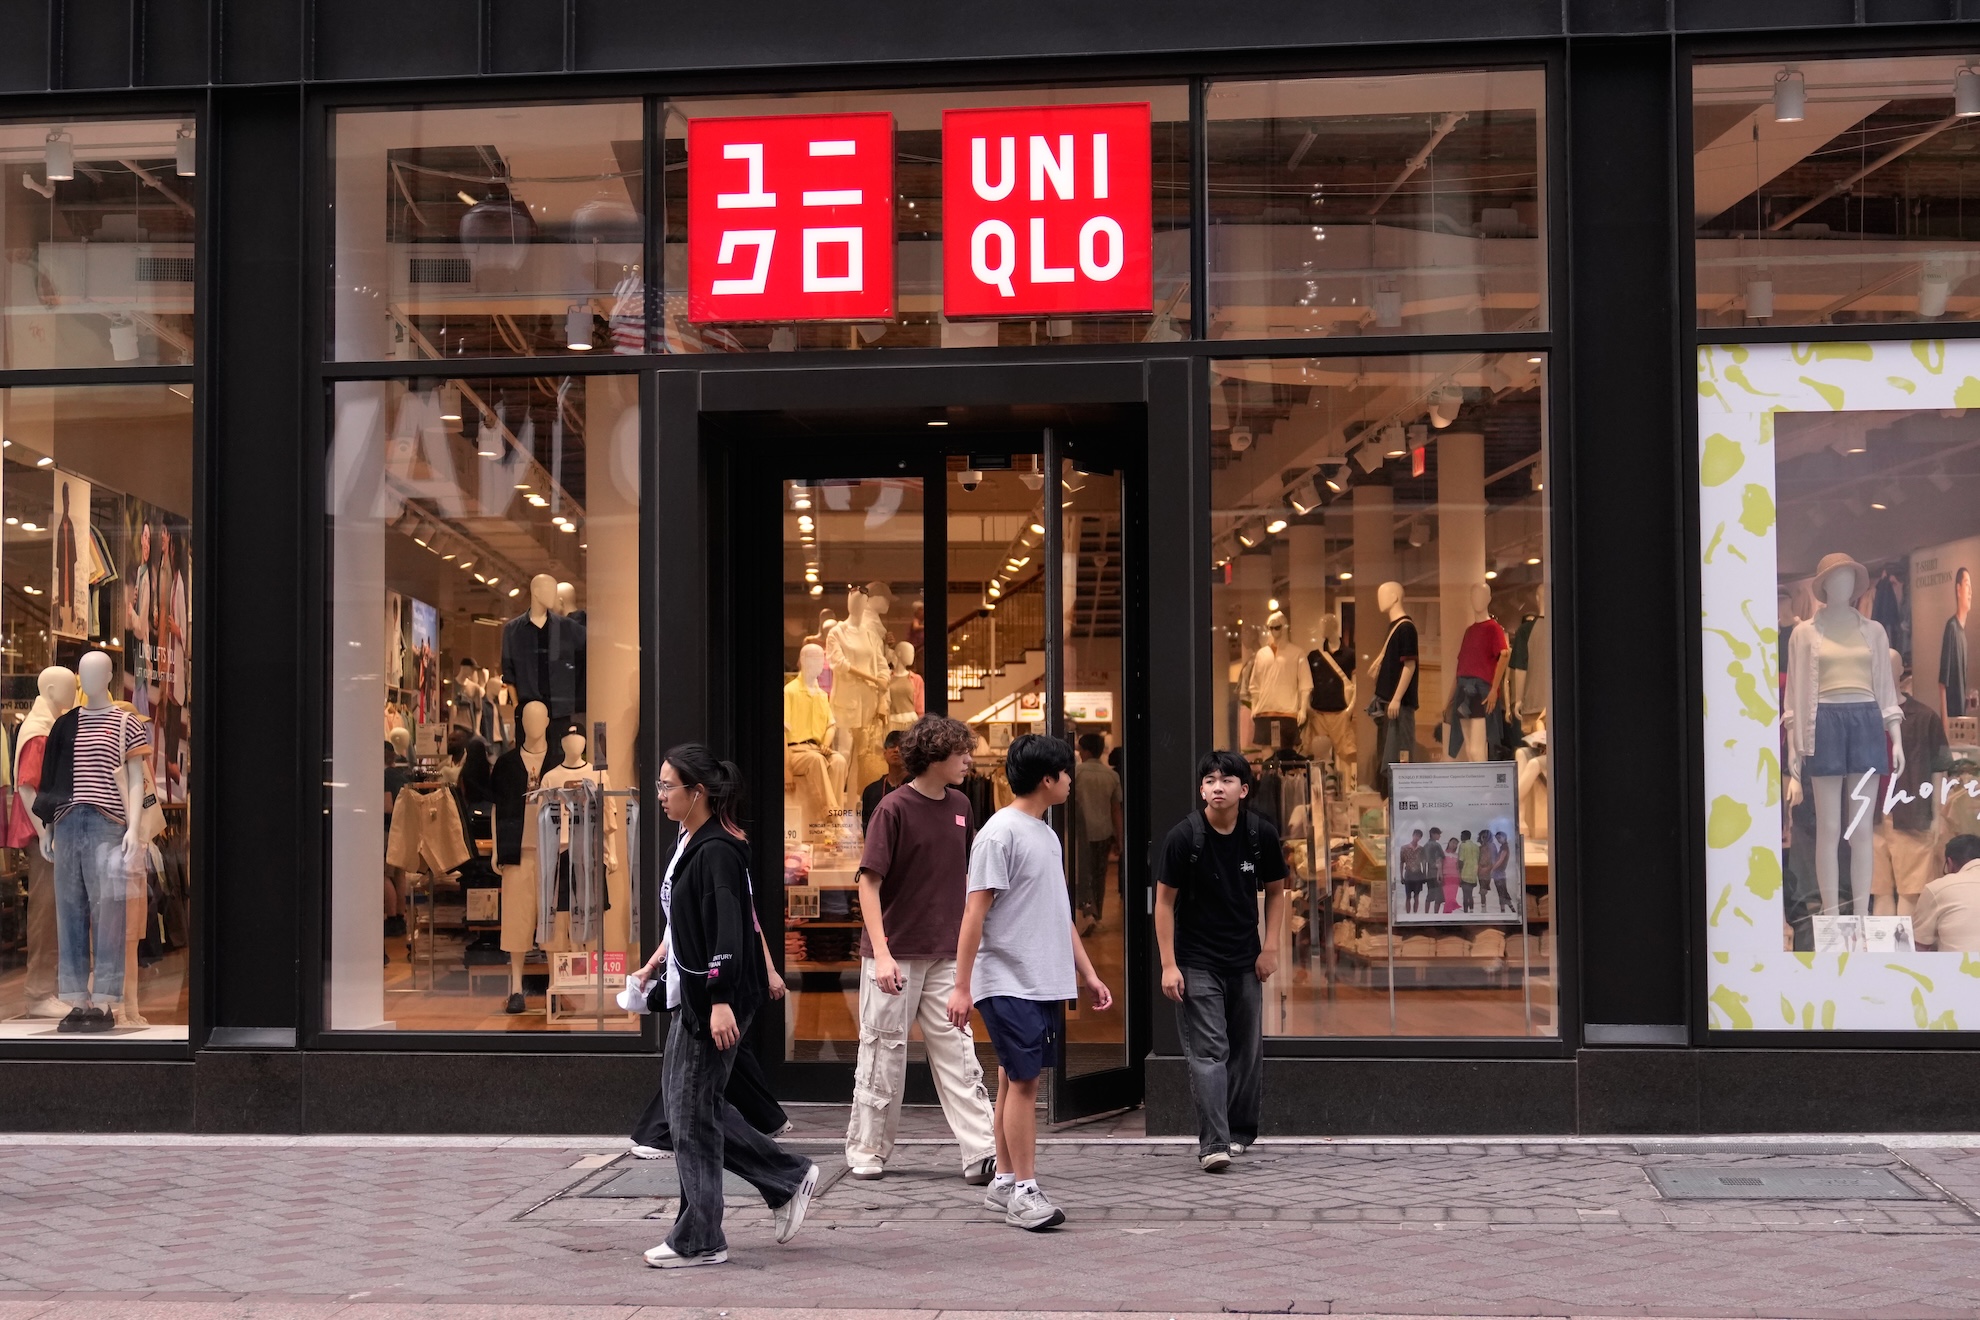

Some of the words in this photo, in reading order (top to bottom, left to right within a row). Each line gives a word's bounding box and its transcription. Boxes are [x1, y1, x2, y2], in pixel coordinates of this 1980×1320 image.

[717, 139, 863, 209] ユニ
[971, 133, 1108, 202] UNI
[711, 227, 863, 295] クロ
[970, 215, 1124, 297] QLO
[1915, 570, 1953, 588] COLLECTION
[1843, 766, 1980, 840] Short
